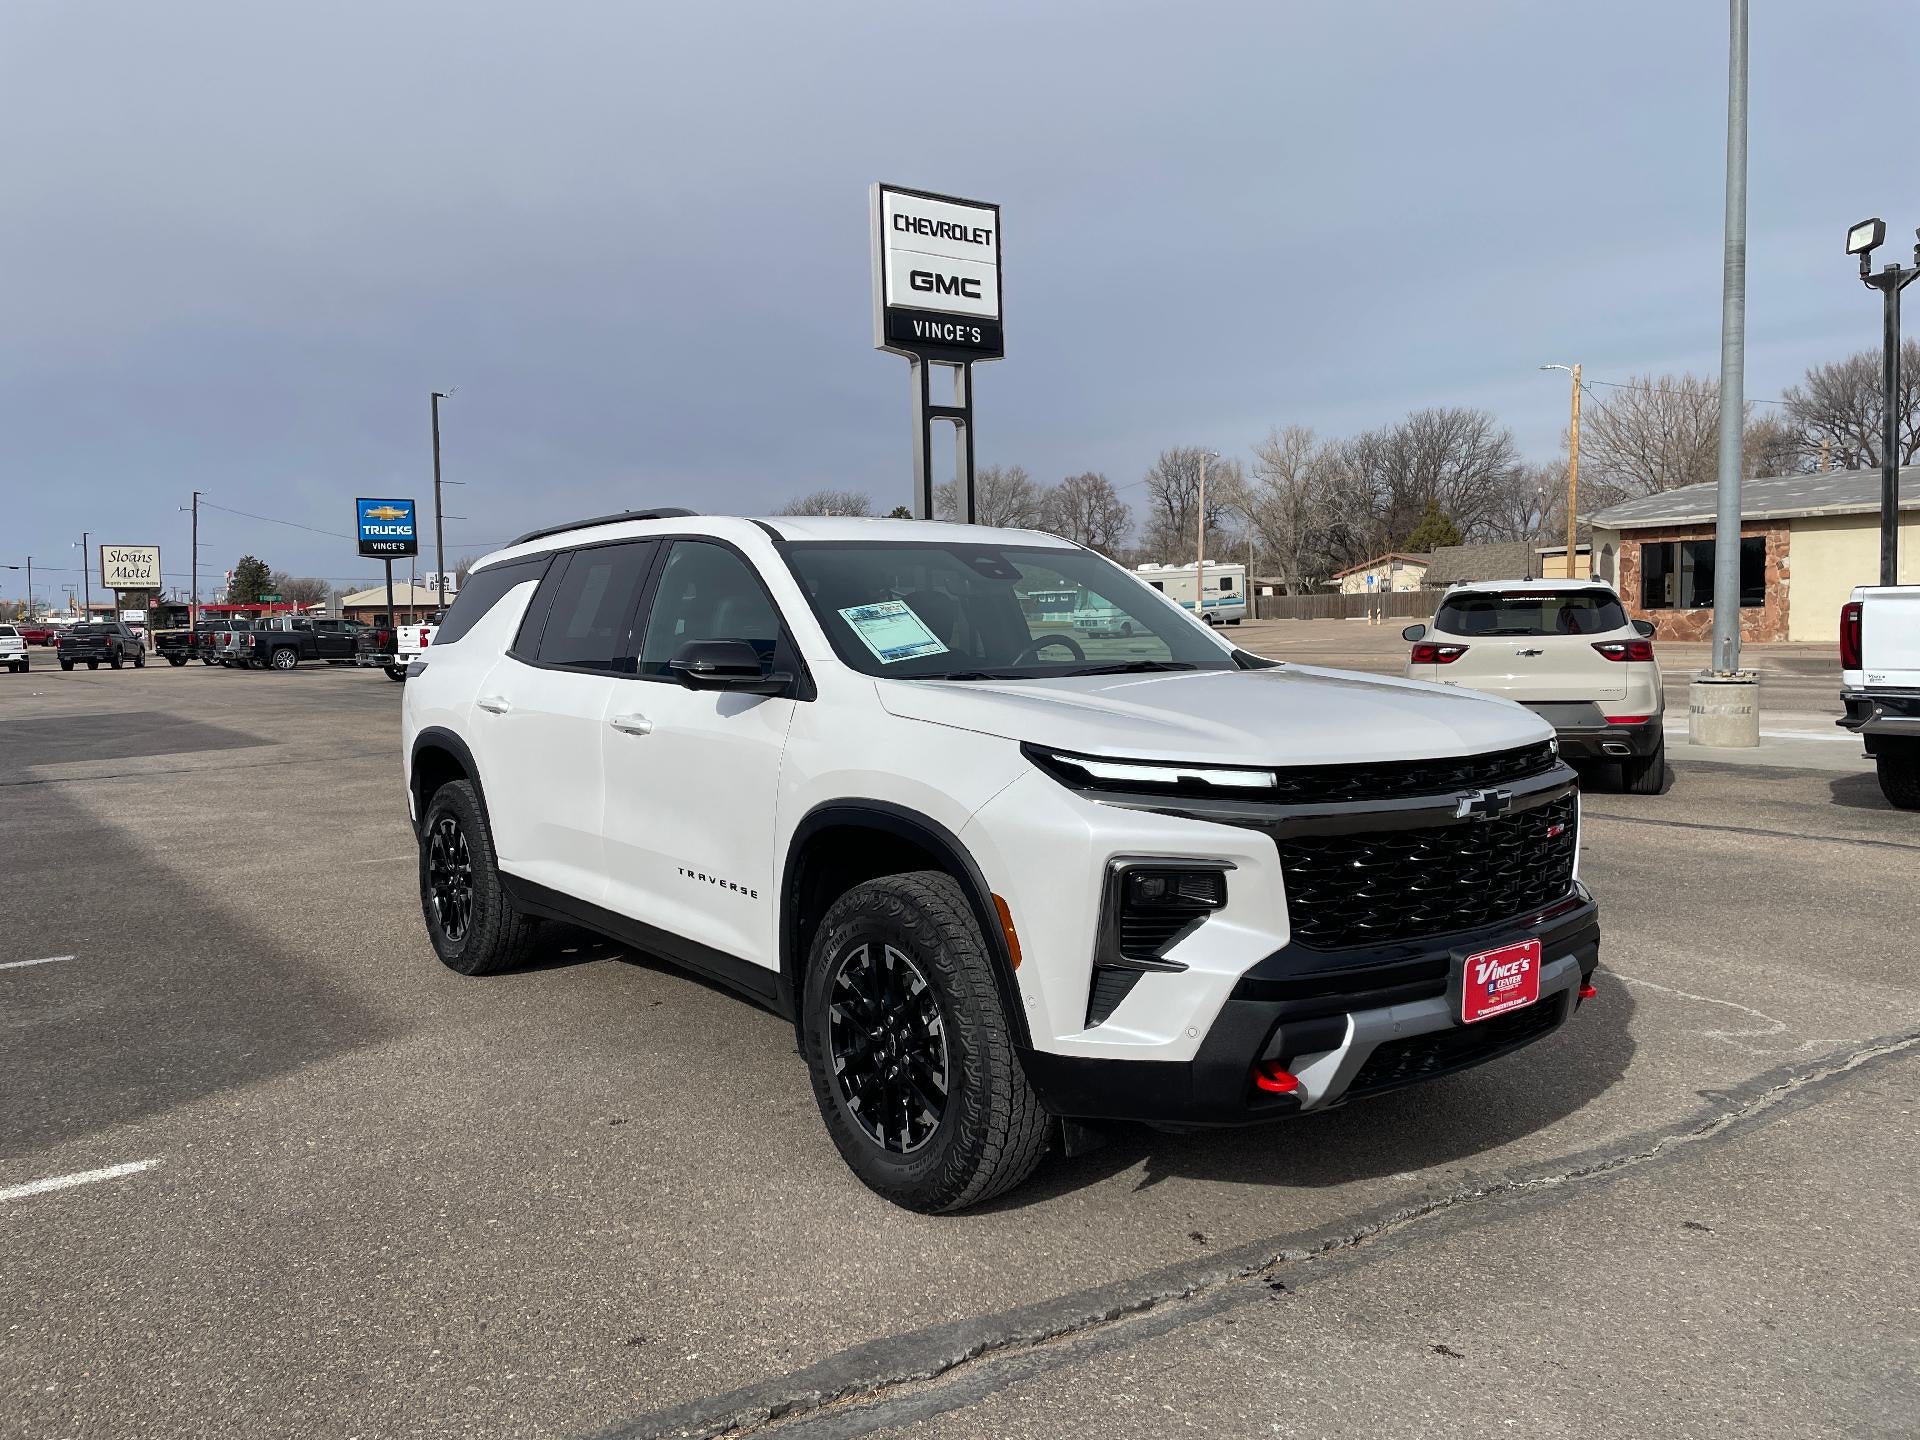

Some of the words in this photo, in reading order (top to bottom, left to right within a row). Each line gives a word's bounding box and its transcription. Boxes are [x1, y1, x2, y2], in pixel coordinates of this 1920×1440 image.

[893, 213, 992, 246] CHEVROLET
[910, 269, 982, 299] GMC
[913, 320, 981, 343] VINCE'S
[362, 525, 413, 535] TRUCKS
[372, 542, 405, 550] VINCE'S
[108, 549, 153, 563] Sloans
[110, 565, 152, 579] Motel
[677, 867, 758, 900] TRAVERSE
[1497, 974, 1522, 989] CENTER
